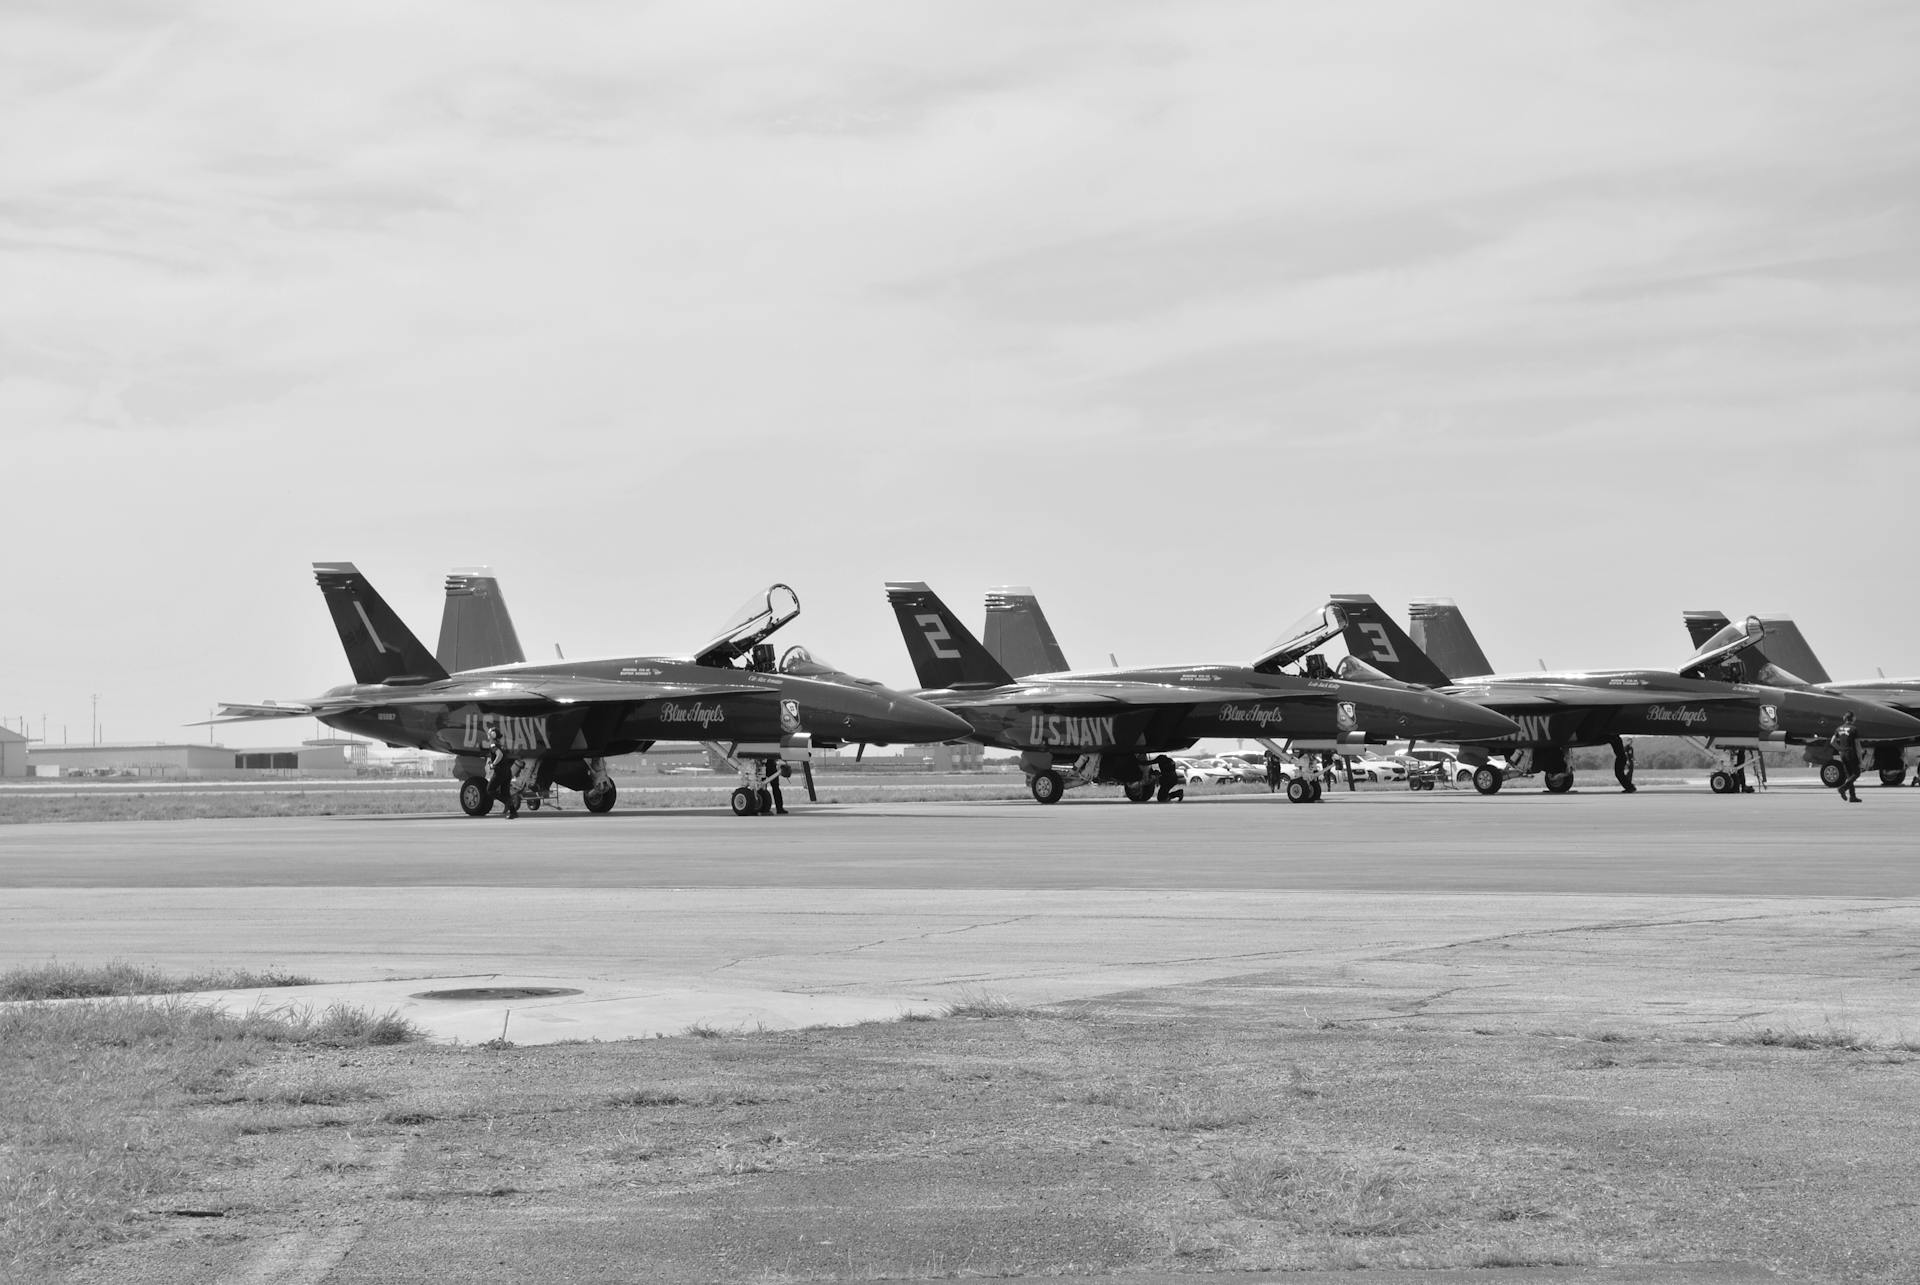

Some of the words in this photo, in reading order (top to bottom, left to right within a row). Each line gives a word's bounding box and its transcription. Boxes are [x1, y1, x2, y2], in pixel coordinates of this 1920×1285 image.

[914, 614, 961, 659] 2
[1358, 623, 1399, 662] 3
[660, 702, 687, 722] Blue
[687, 702, 725, 729] Angels
[1219, 704, 1245, 721] Blue
[1245, 704, 1283, 728] Angels
[1646, 705, 1672, 720] Blue
[1672, 705, 1707, 727] Angels
